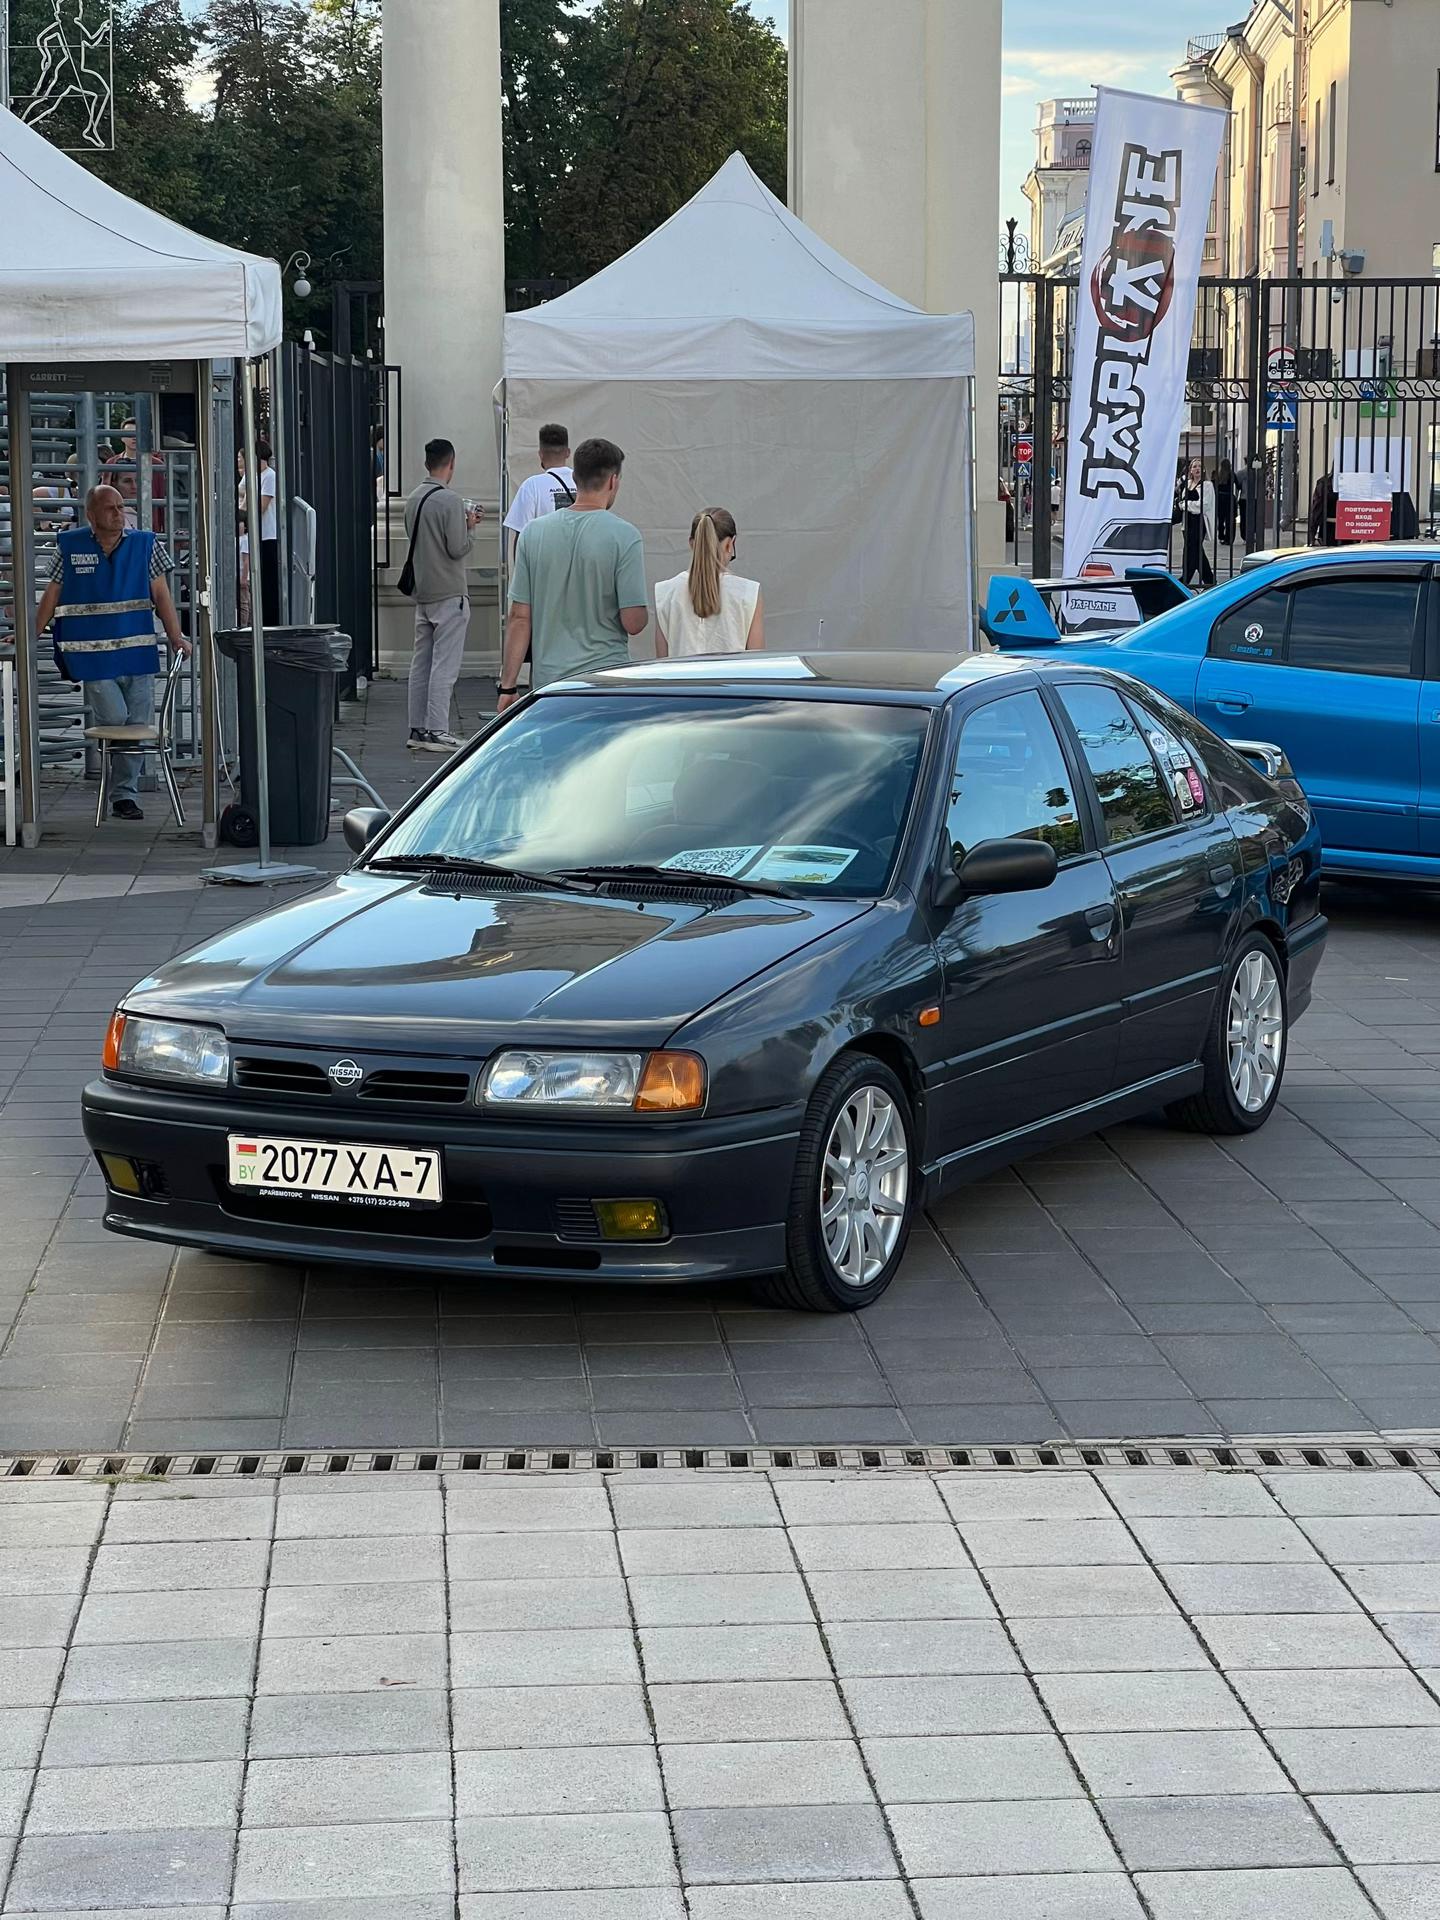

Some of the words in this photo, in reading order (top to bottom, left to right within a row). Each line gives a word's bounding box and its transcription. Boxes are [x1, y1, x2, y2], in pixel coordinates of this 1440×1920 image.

[1081, 143, 1182, 500] JAPLANE
[30, 373, 67, 381] GARRETT
[1071, 599, 1117, 612] JAPLANE
[329, 1068, 361, 1077] NISSAN
[239, 1165, 256, 1180] BY
[262, 1144, 338, 1186] 2077
[259, 1188, 303, 1199] ДРАЙВМОТОРС
[311, 1193, 339, 1202] NISSAN
[348, 1196, 364, 1205] +375
[364, 1197, 377, 1206] (17)
